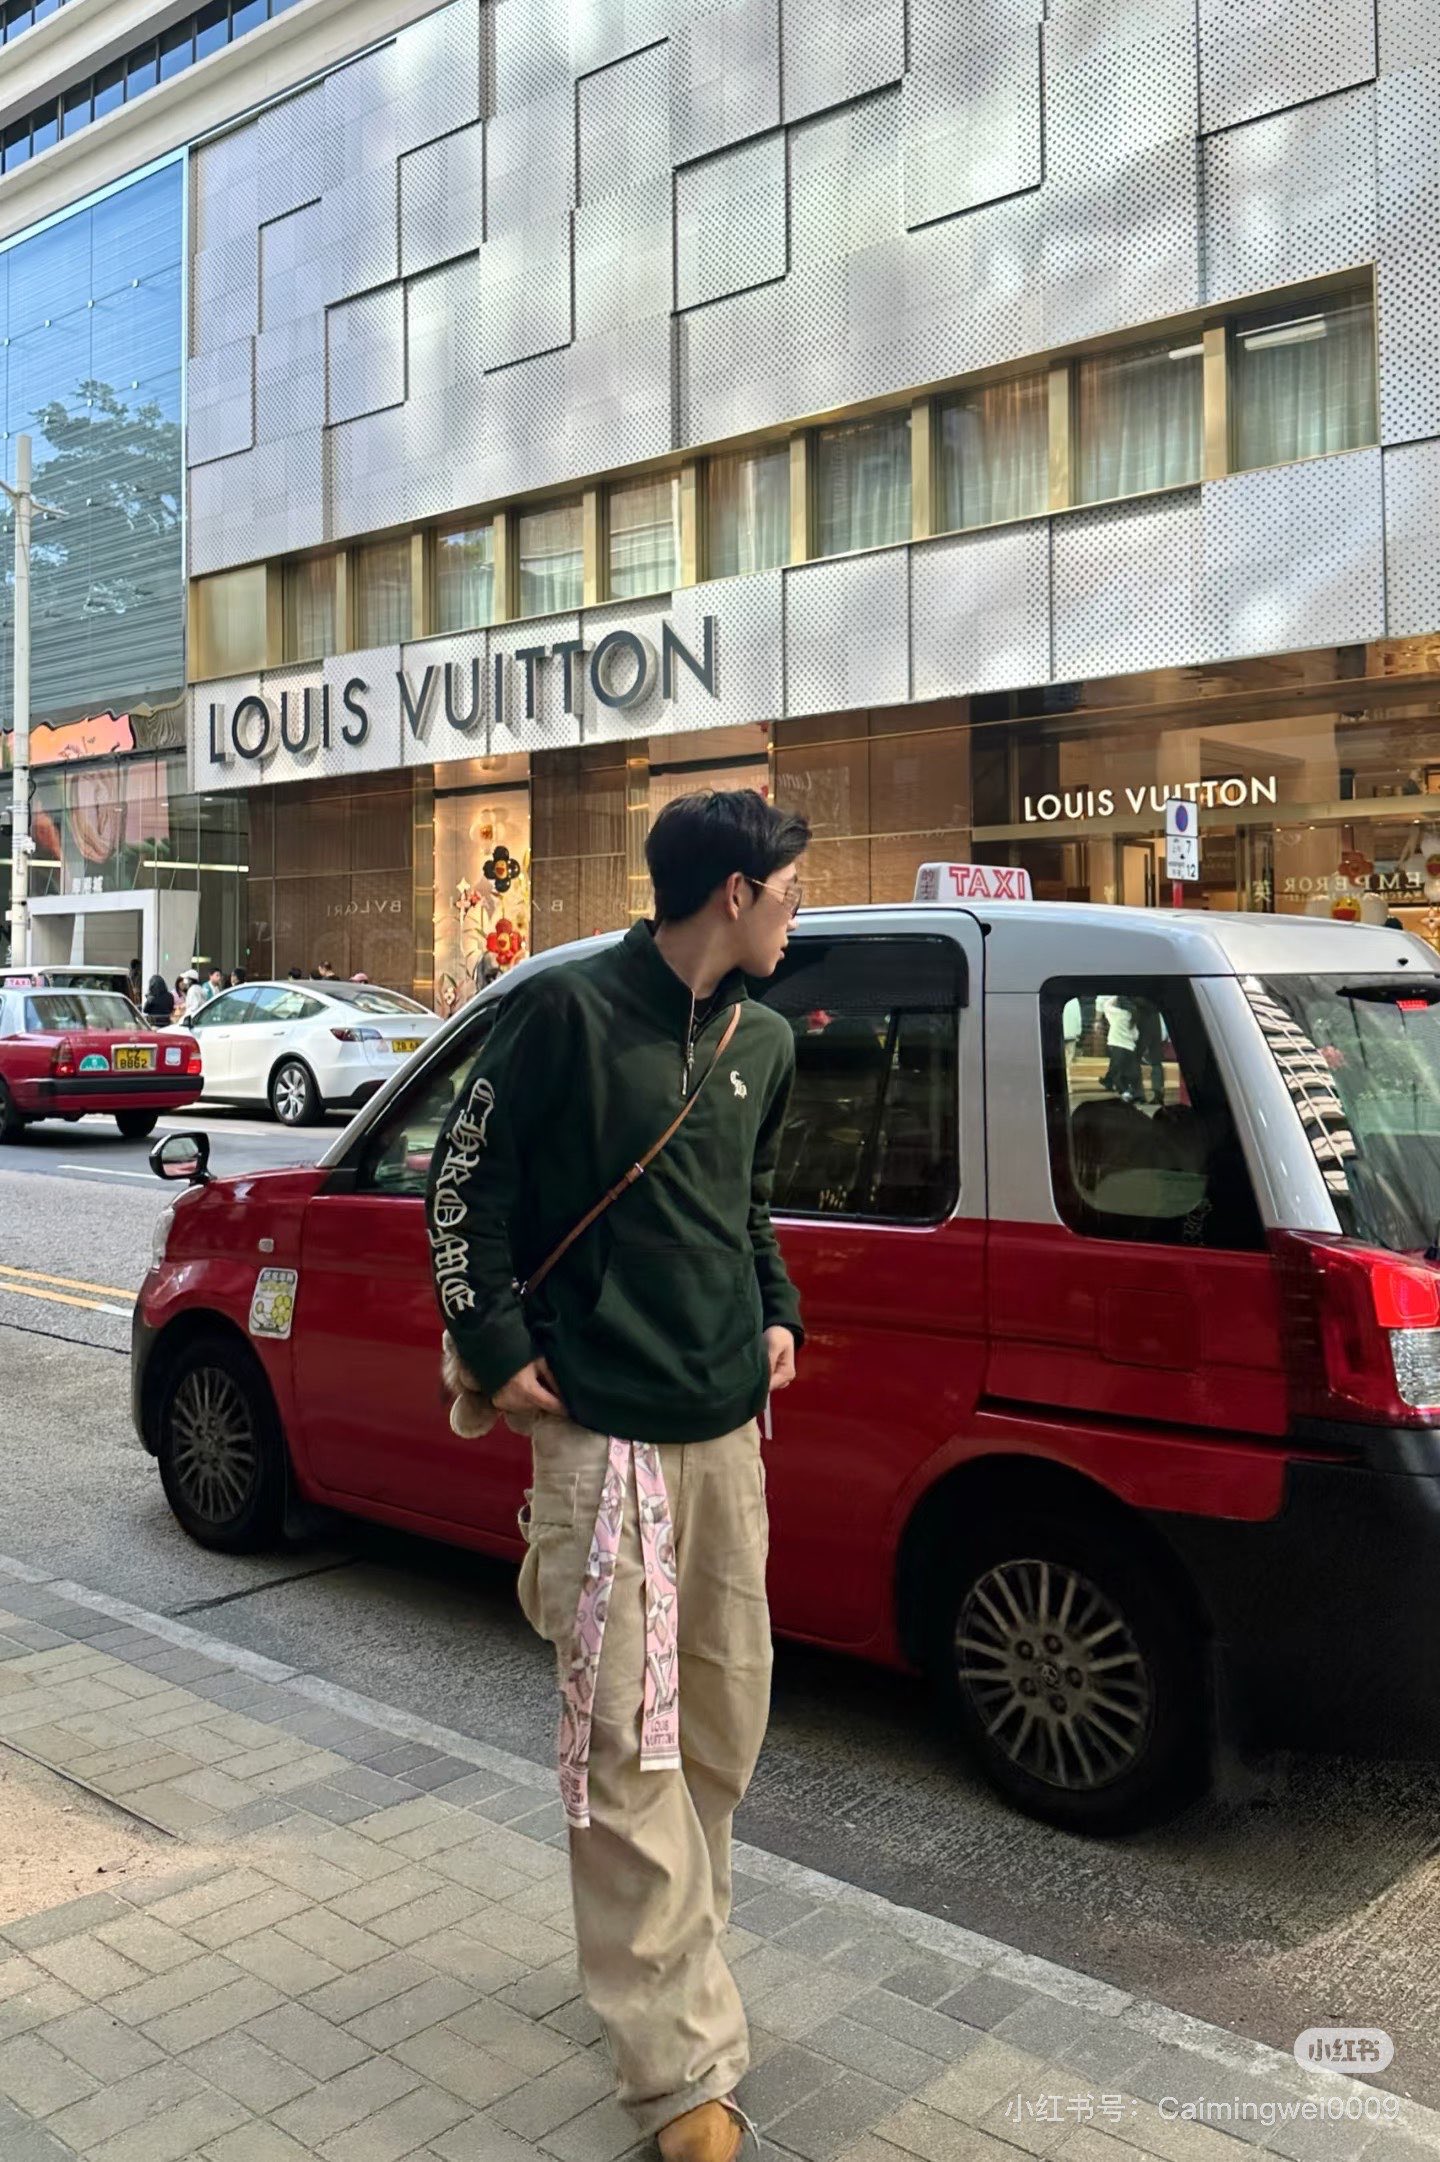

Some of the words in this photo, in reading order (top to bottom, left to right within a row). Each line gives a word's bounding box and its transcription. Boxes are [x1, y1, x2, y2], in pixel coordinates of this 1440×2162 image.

[210, 677, 370, 765] LOUIS
[396, 615, 717, 741] VUITTON
[1024, 789, 1115, 822] LOUIS
[948, 866, 1026, 900] TAXI
